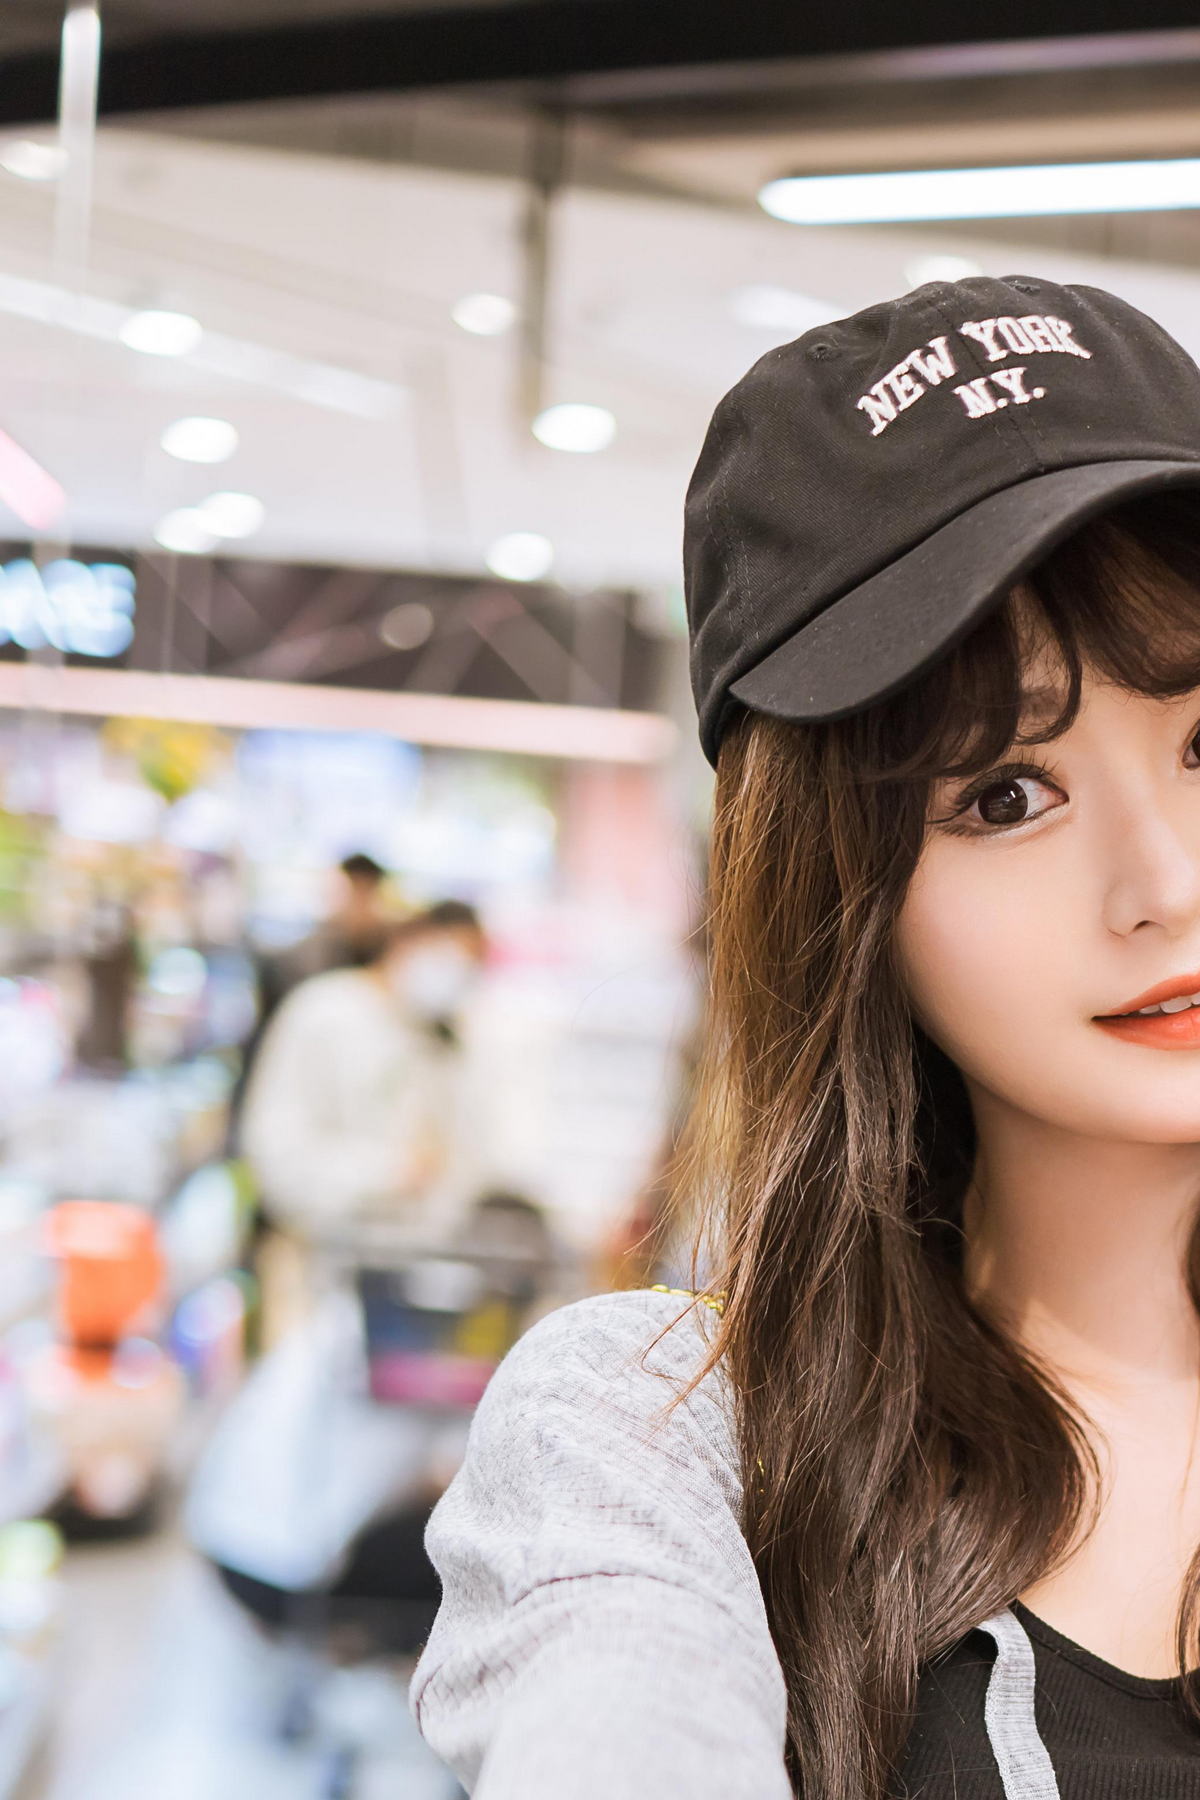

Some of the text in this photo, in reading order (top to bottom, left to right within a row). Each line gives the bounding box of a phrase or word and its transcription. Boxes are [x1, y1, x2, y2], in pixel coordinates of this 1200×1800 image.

[856, 315, 1093, 437] NEW YORK
[952, 367, 1044, 419] N.Y.
